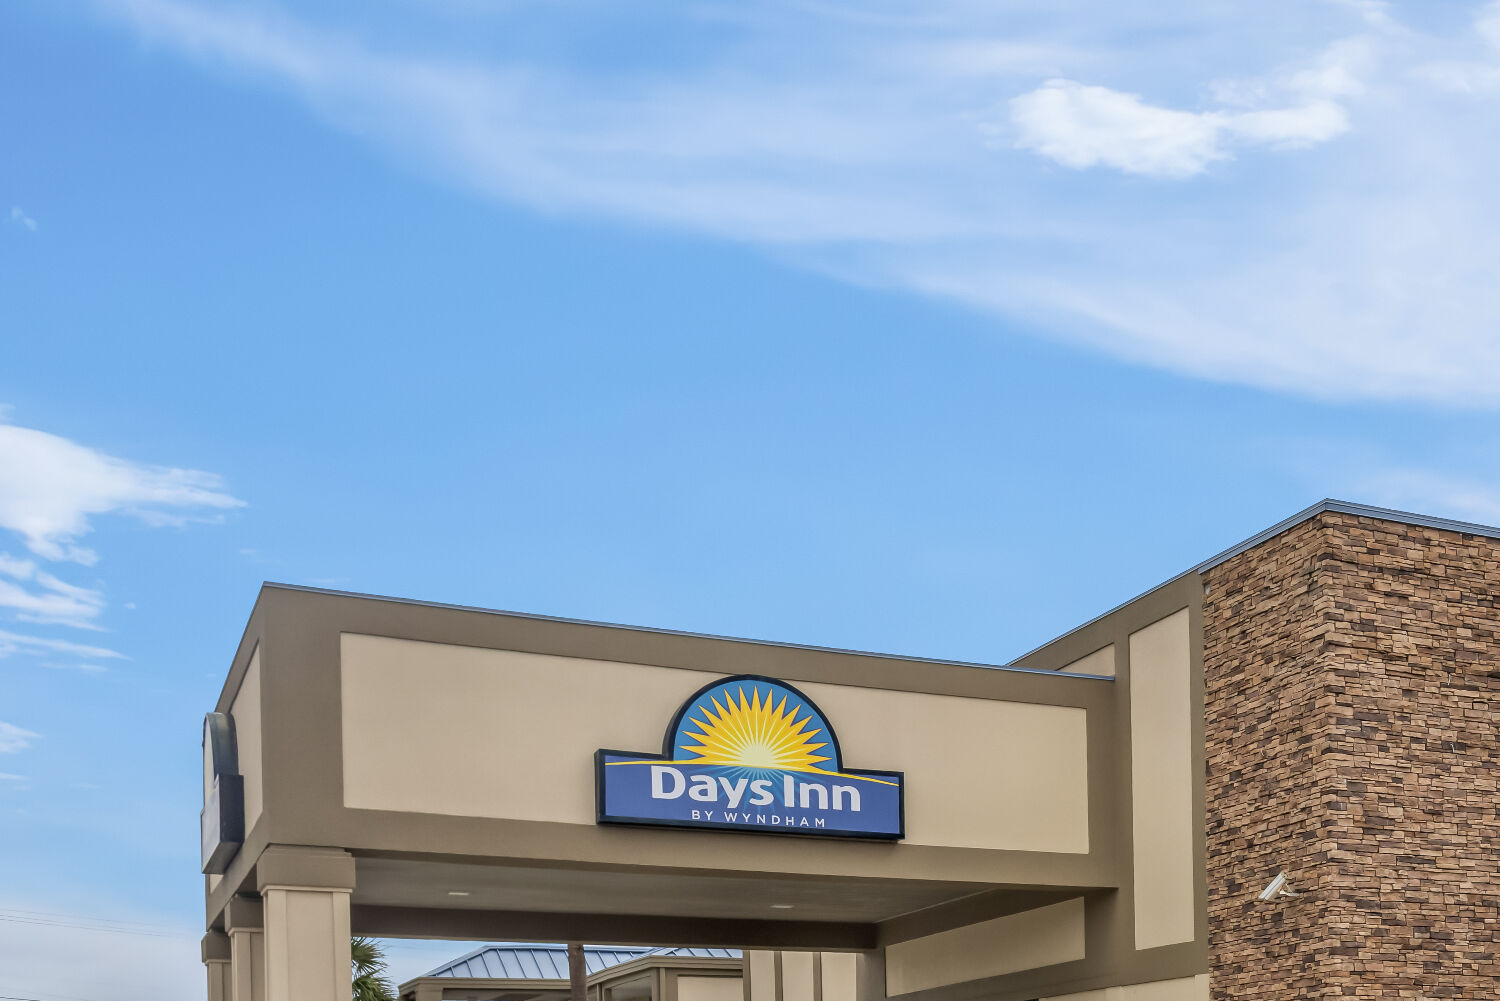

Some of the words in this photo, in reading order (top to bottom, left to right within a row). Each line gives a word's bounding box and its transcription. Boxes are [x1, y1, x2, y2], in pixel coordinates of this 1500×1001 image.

[651, 765, 774, 809] Days
[784, 775, 860, 812] Inn
[691, 809, 713, 821] BY
[724, 811, 825, 828] WYNDHAM
